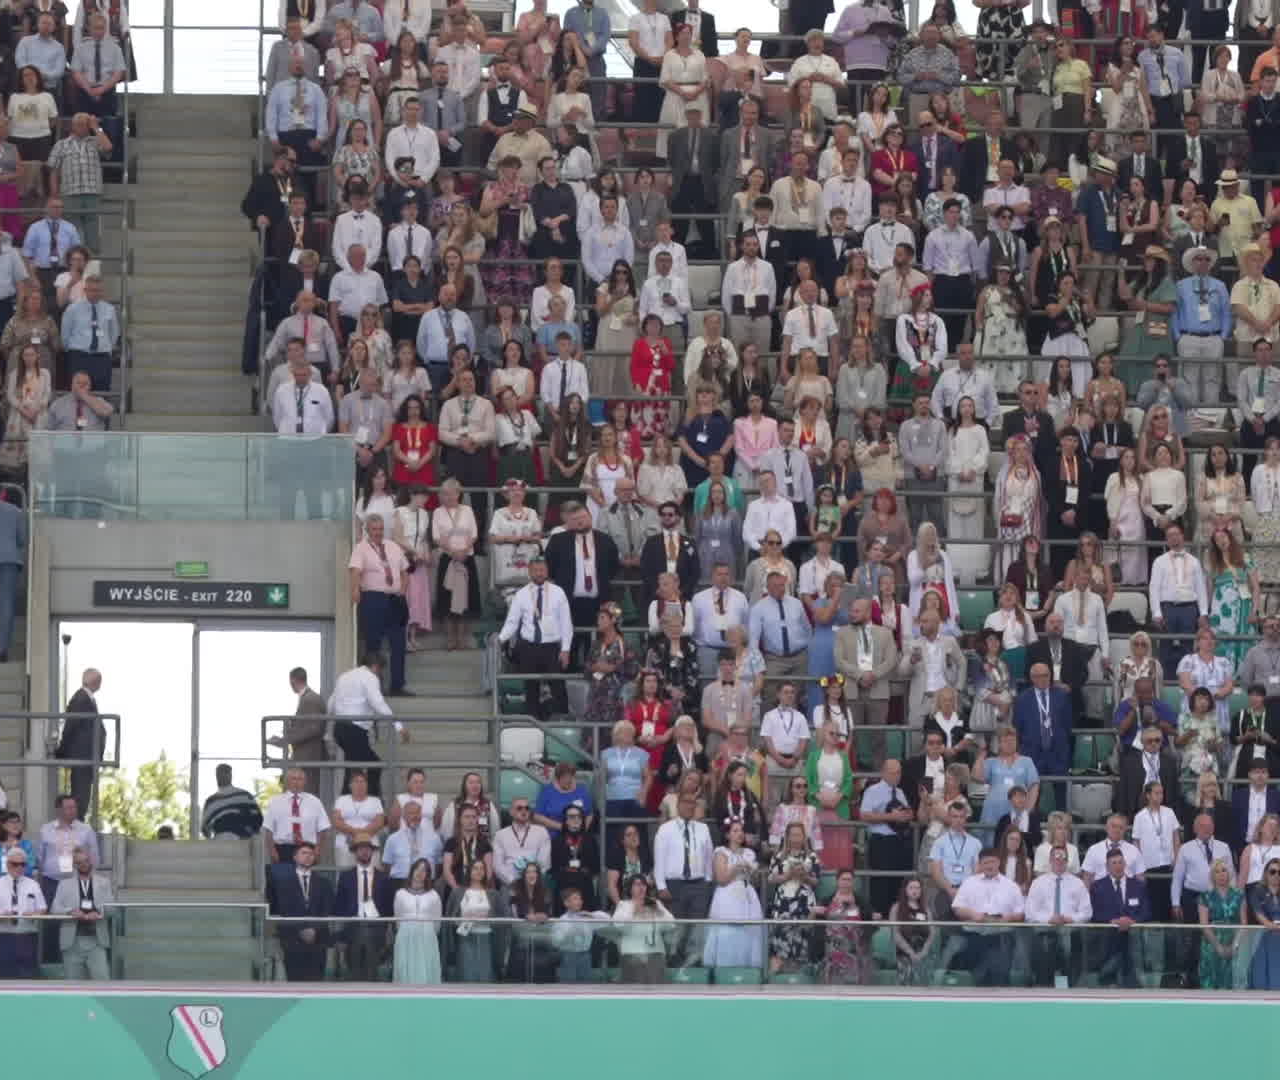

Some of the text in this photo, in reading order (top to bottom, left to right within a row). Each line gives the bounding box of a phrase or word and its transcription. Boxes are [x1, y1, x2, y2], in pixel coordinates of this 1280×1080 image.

[109, 586, 179, 601] WYJŚCIE
[192, 591, 218, 602] EXIT
[226, 589, 252, 602] 220
